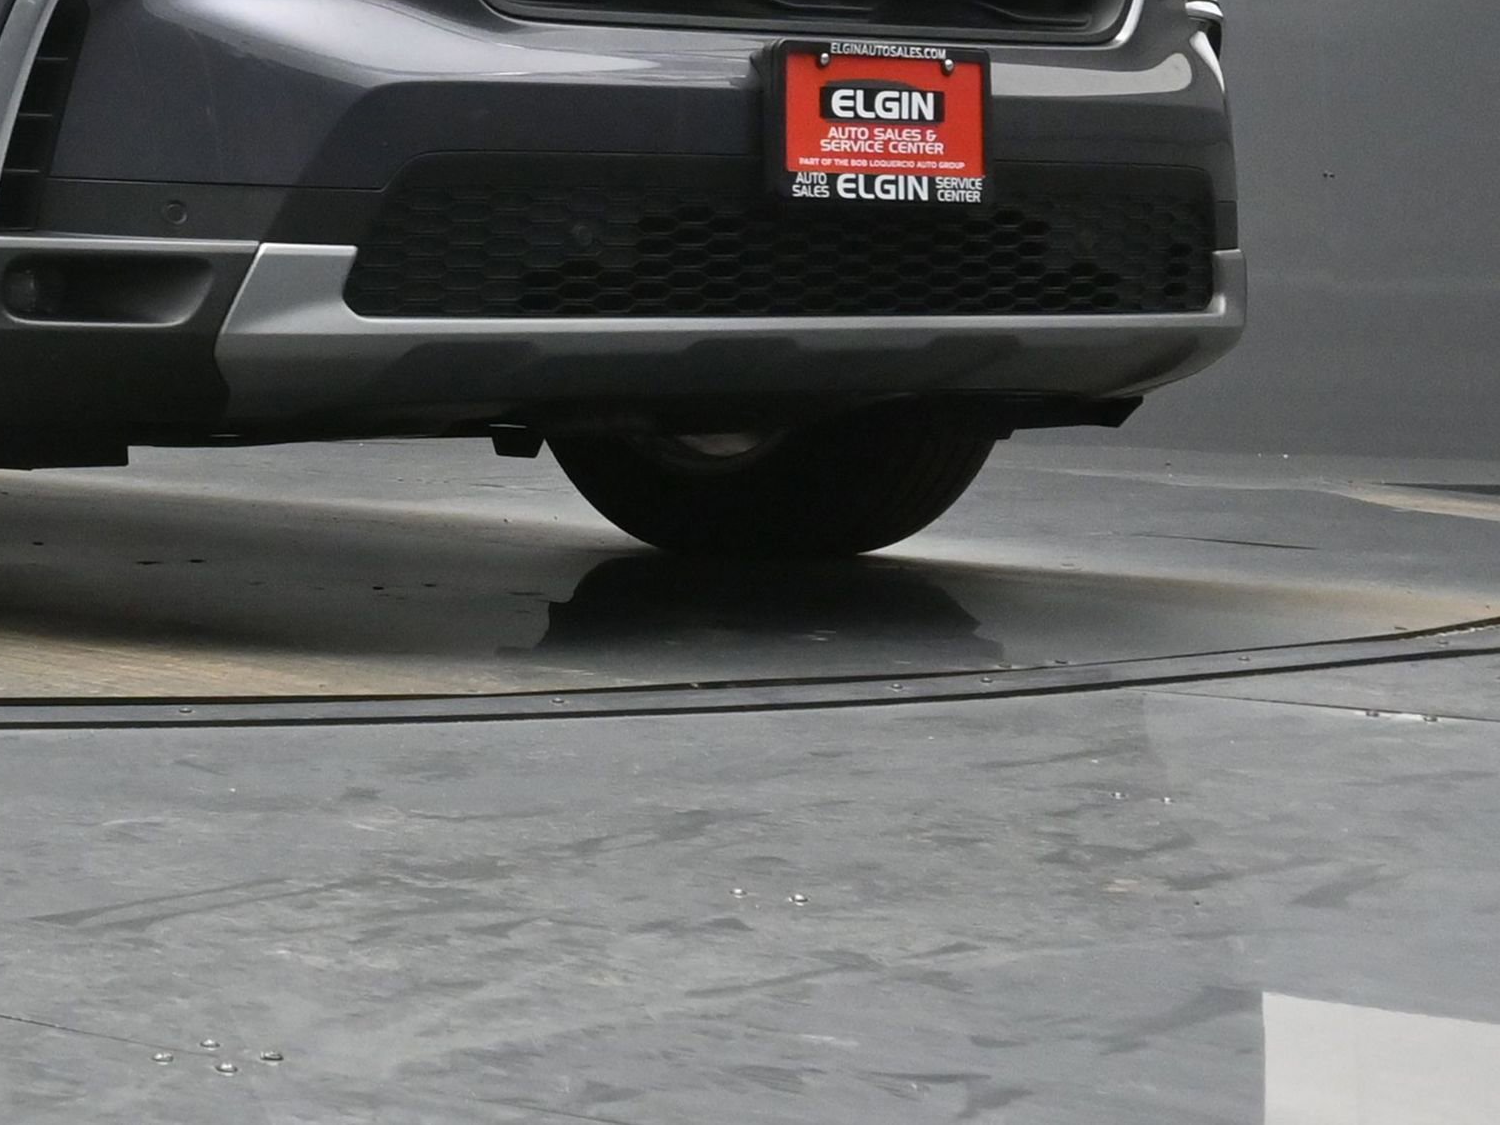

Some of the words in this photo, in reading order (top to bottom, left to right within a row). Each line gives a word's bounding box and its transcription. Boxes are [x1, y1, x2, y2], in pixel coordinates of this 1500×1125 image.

[830, 42, 947, 60] ELGINAUTOSALES.COM
[831, 89, 935, 121] ELGIN
[827, 127, 869, 140] AUTO
[873, 128, 922, 141] SALES
[925, 129, 937, 141] &
[820, 139, 884, 153] SERVICE
[888, 141, 944, 155] CENTER
[799, 157, 819, 166] PART
[821, 158, 833, 166] OF
[834, 158, 849, 167] THE
[851, 159, 868, 167] BOB
[916, 161, 937, 169] AUTO
[938, 162, 966, 170] GROUP
[795, 172, 827, 184] AUTO
[935, 177, 983, 191] SERVICE
[792, 185, 830, 198] SALES
[836, 173, 929, 201] ELGIN
[937, 189, 981, 203] CENTER
